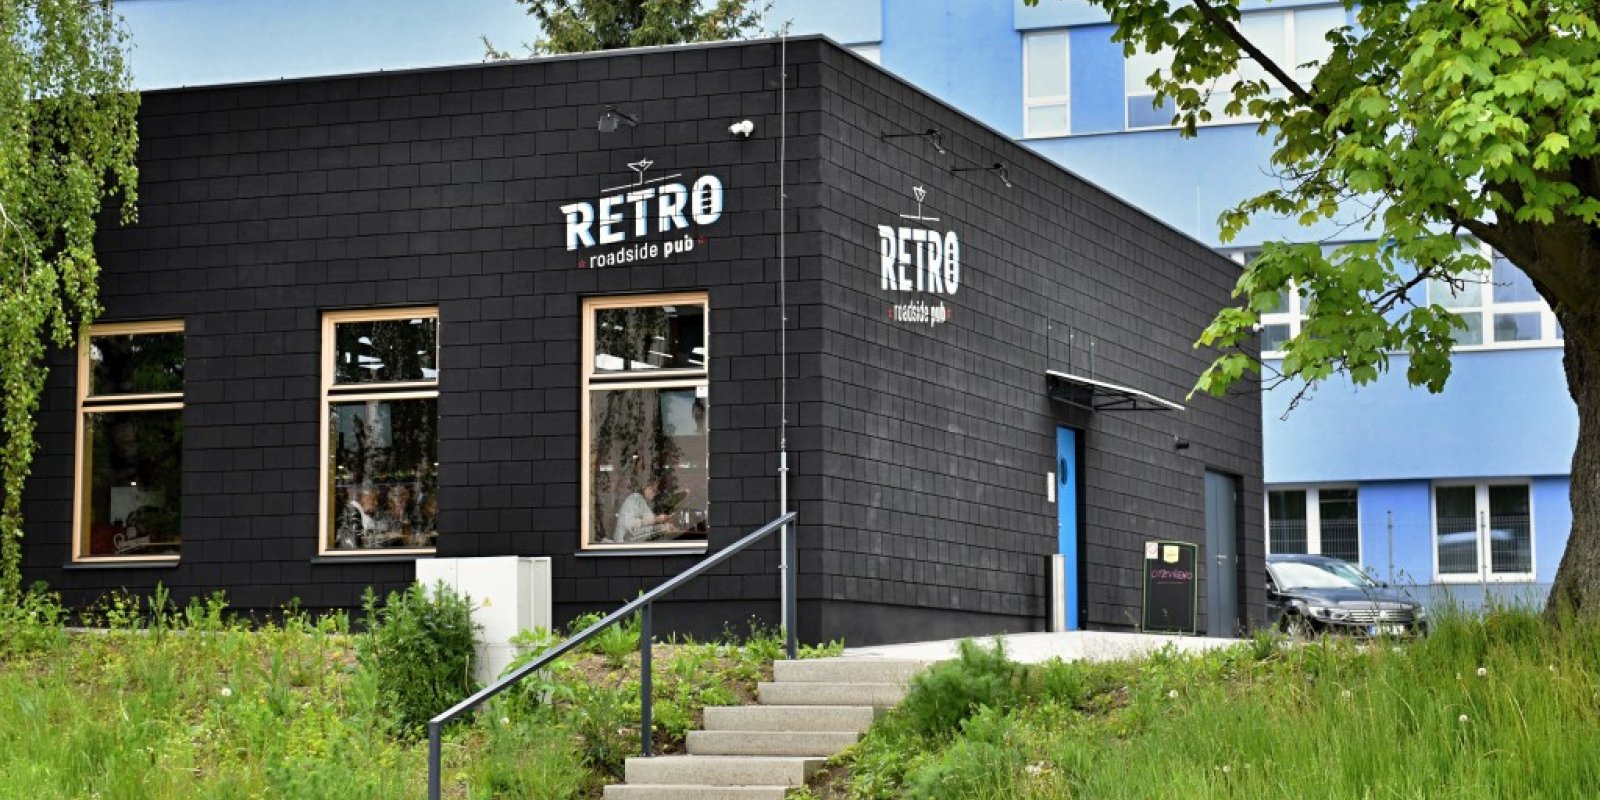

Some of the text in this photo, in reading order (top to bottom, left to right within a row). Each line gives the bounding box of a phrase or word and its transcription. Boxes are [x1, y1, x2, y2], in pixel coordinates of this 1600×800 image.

[559, 174, 723, 251] RETRO
[590, 235, 694, 269] roadside pub
[877, 224, 960, 295] RETRO
[893, 300, 946, 327] roadside pub
